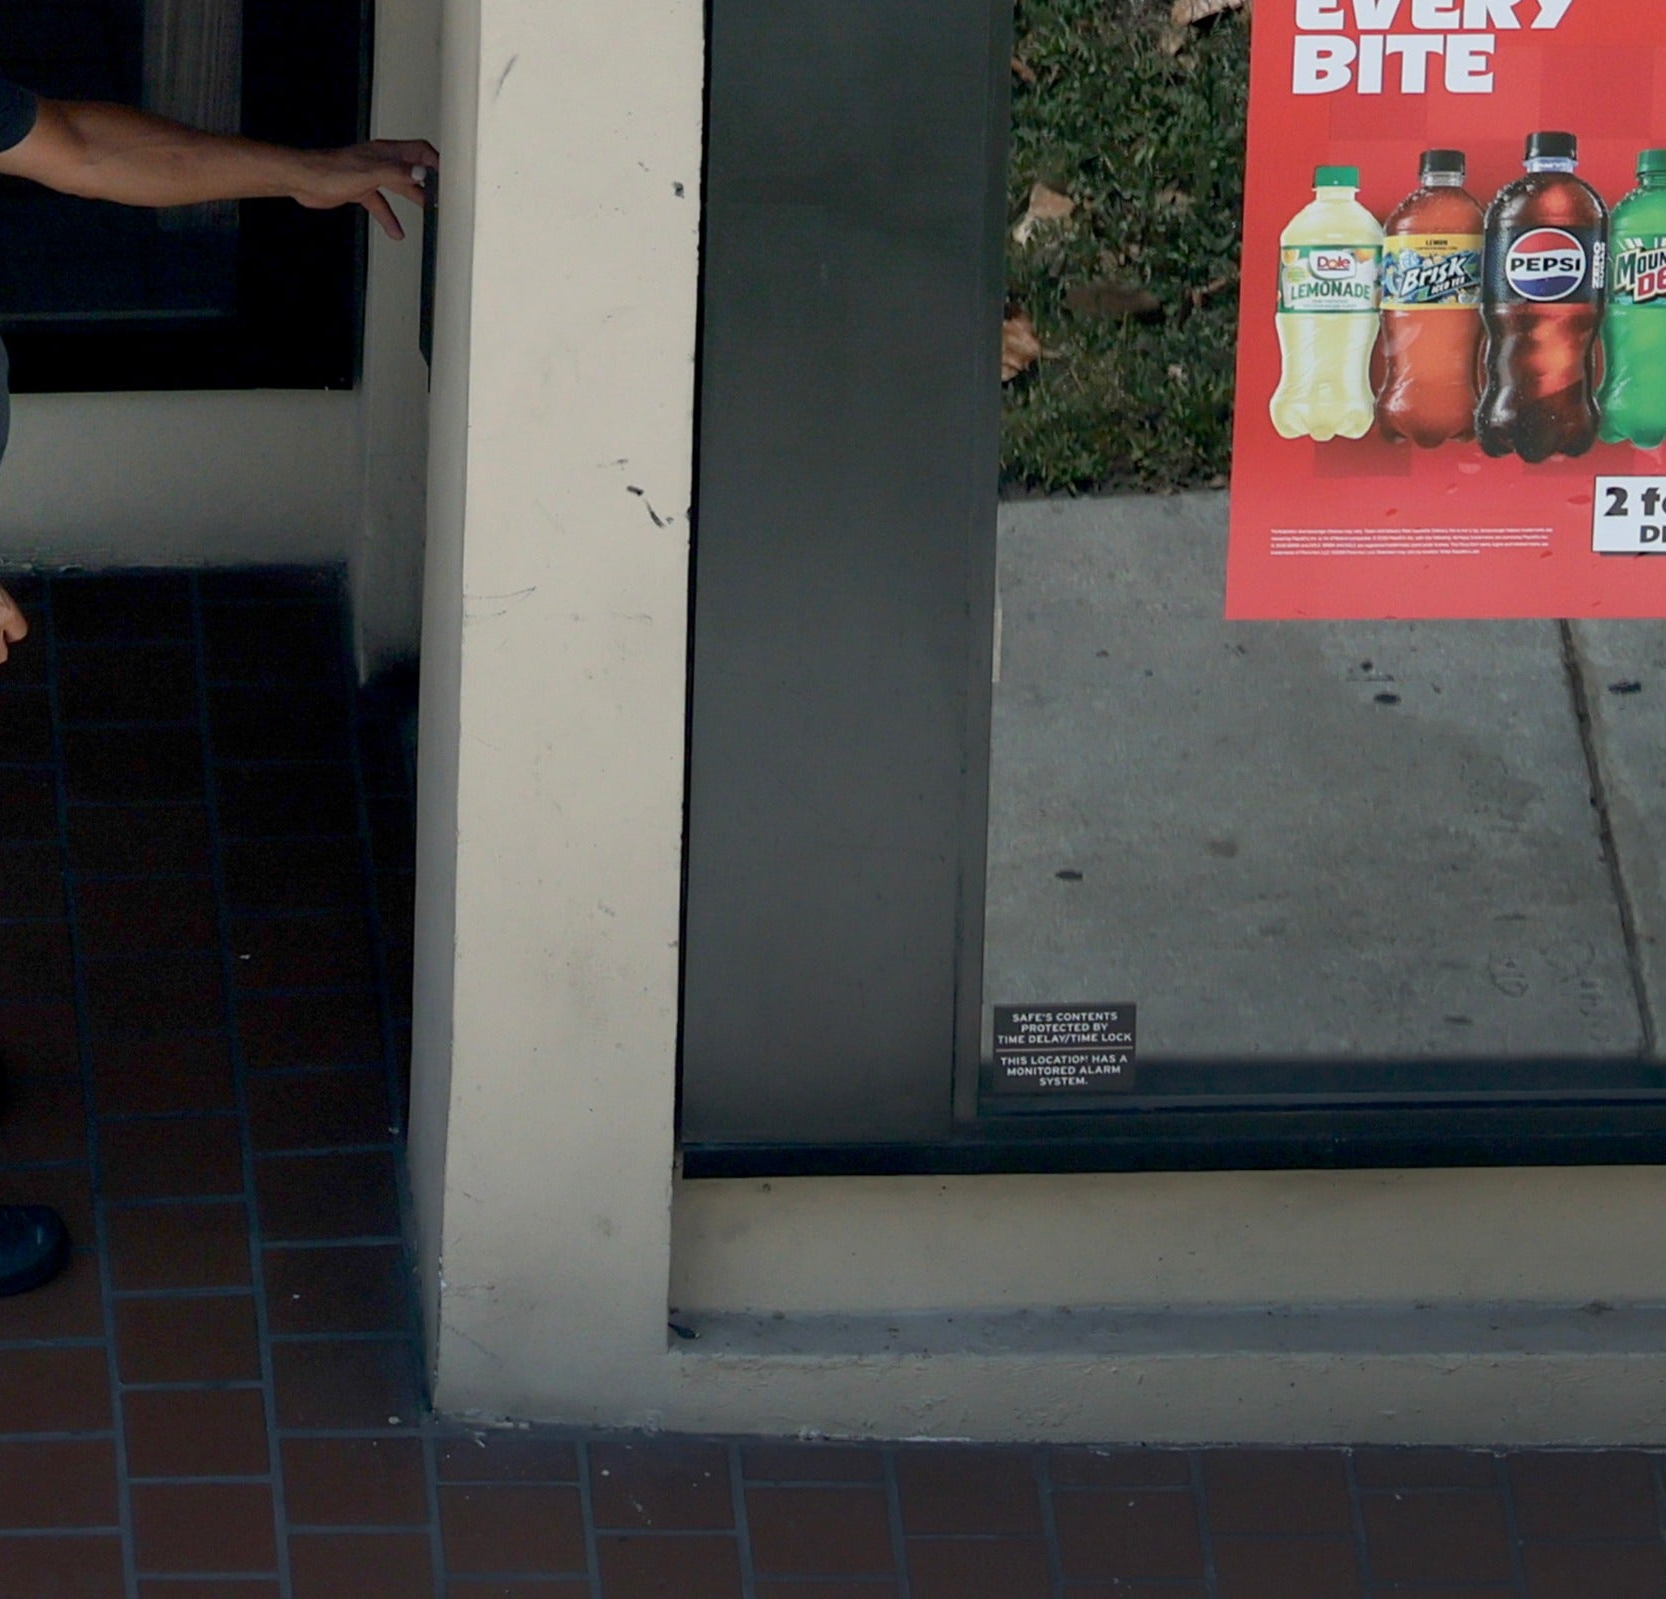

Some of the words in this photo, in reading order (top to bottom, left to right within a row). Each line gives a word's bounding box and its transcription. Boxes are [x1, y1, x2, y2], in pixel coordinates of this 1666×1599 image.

[1291, 34, 1495, 94] BITE
[1316, 255, 1351, 271] Dole
[1510, 257, 1581, 272] PEPSI
[1290, 281, 1371, 300] LEMONADE
[1604, 486, 1628, 516] 2
[1012, 1012, 1053, 1023] SAFE'S
[1056, 1011, 1118, 1022] CONTENTS
[1020, 1023, 1090, 1033] PROTECTED
[1093, 1023, 1109, 1032] BY
[997, 1035, 1025, 1045] TIME
[1028, 1033, 1098, 1044] DELAY/TIME
[1101, 1032, 1132, 1042] LOCK
[1000, 1056, 1028, 1066] THIS
[1091, 1054, 1116, 1064] HAS
[1119, 1054, 1128, 1063] A
[1007, 1066, 1076, 1076] MONITORED
[1079, 1065, 1121, 1075] ALARM
[1039, 1077, 1089, 1087] SYSTEM.
